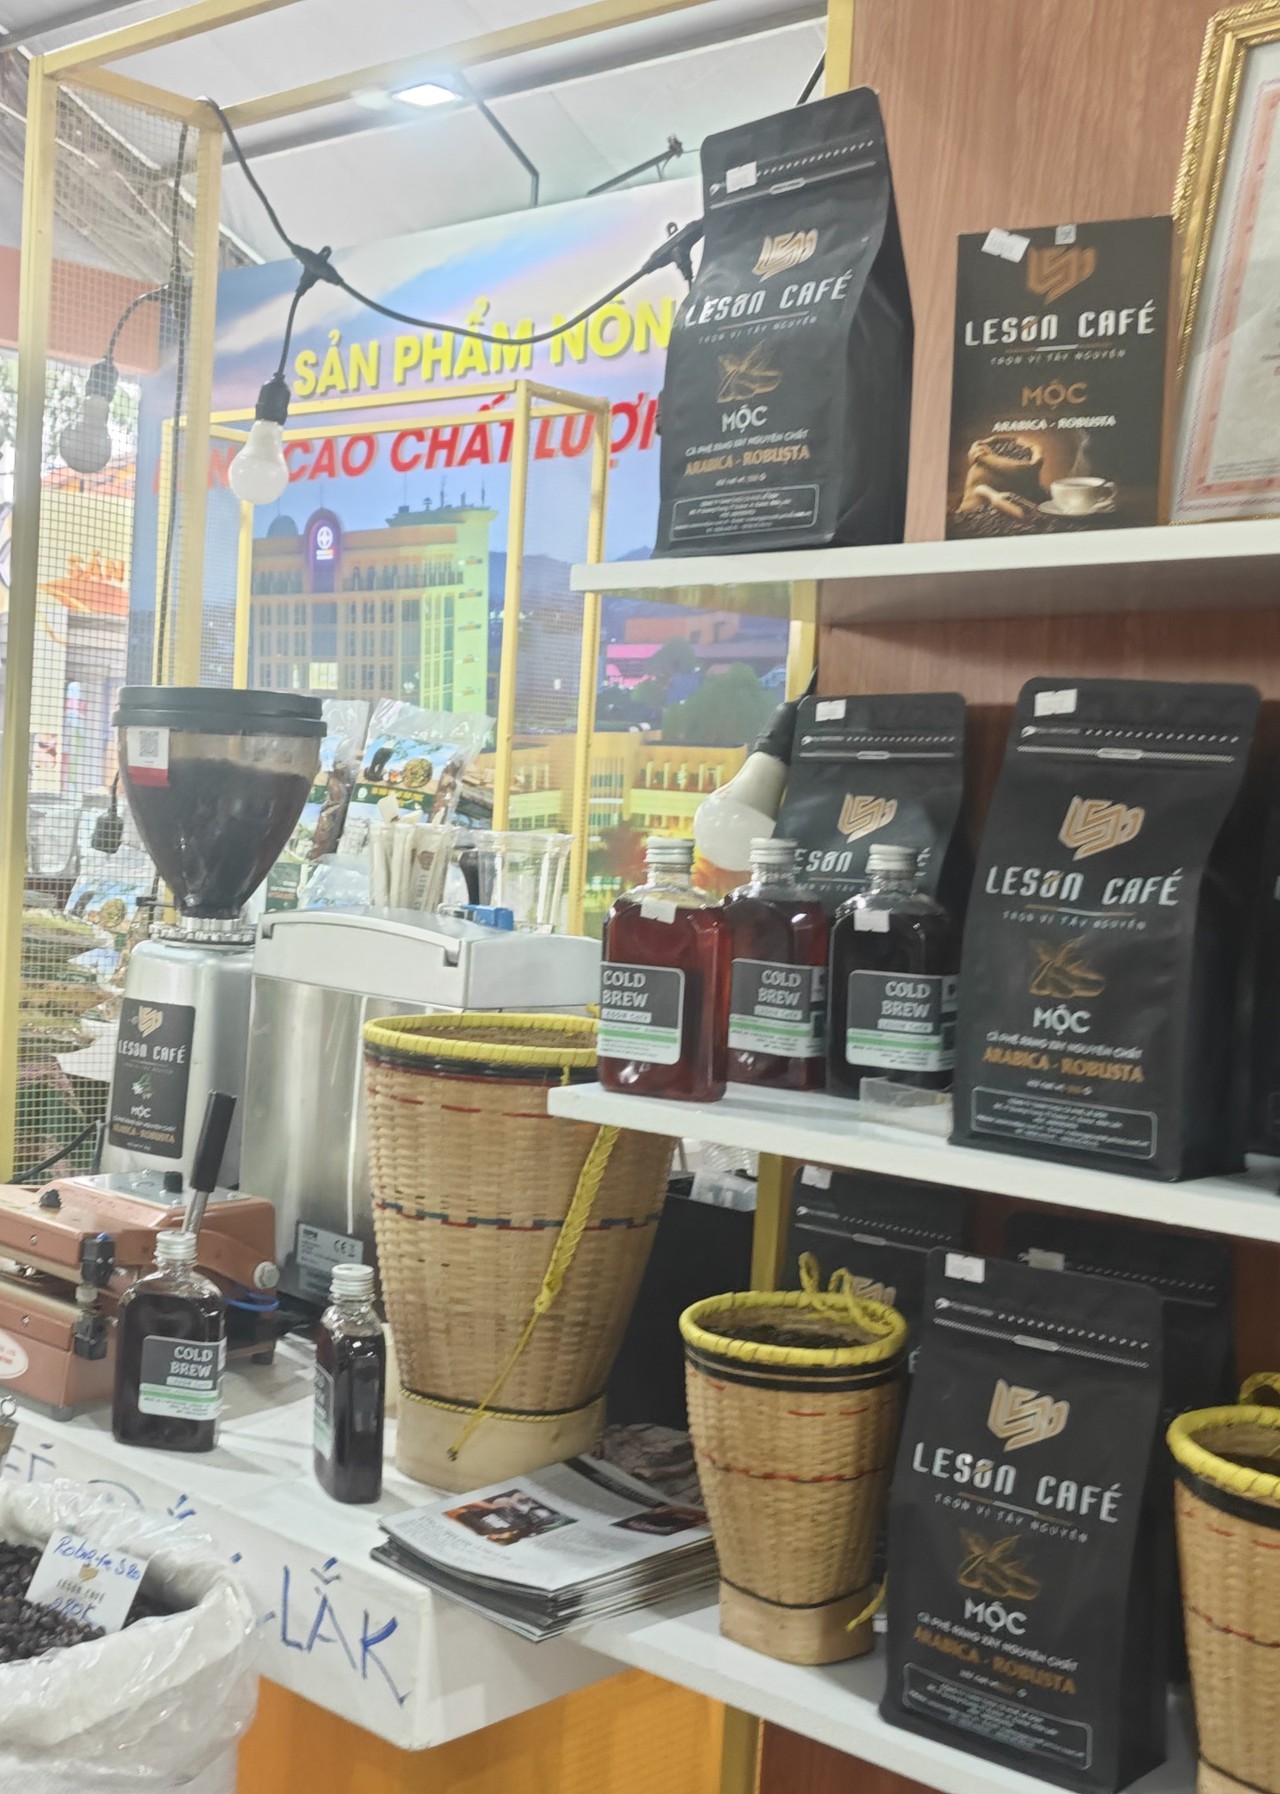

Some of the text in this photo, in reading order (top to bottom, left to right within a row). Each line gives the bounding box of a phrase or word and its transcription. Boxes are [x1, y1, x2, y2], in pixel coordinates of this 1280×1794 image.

[779, 269, 853, 310] CAFÉ
[1078, 299, 1156, 339] CAFÉ
[294, 329, 379, 398] SẢN
[394, 296, 532, 383] PHẨM
[1022, 377, 1088, 410] MỘC
[722, 404, 768, 433] MỘC
[991, 415, 1117, 433] ARABICA ROBUSTA
[283, 433, 377, 483] CAO
[684, 445, 811, 476] ARABICA ROBUSTA
[1101, 867, 1183, 906] CAFÉ
[603, 970, 646, 987] COLD
[761, 969, 801, 987] COLD
[885, 981, 931, 998] COLD
[602, 990, 648, 1008] BREW
[758, 988, 800, 1006] BREW
[881, 1000, 930, 1018] BREW
[1033, 1003, 1092, 1036] MỘC
[153, 1045, 187, 1064] CAFÉ
[983, 1046, 1145, 1084] ARABICA ROBUSTA
[169, 1361, 212, 1377] BREW
[174, 1346, 213, 1361] COLD
[1035, 1475, 1123, 1524] CAFÉ
[964, 1597, 1028, 1636] MỘC
[281, 1557, 412, 1708] LẮK
